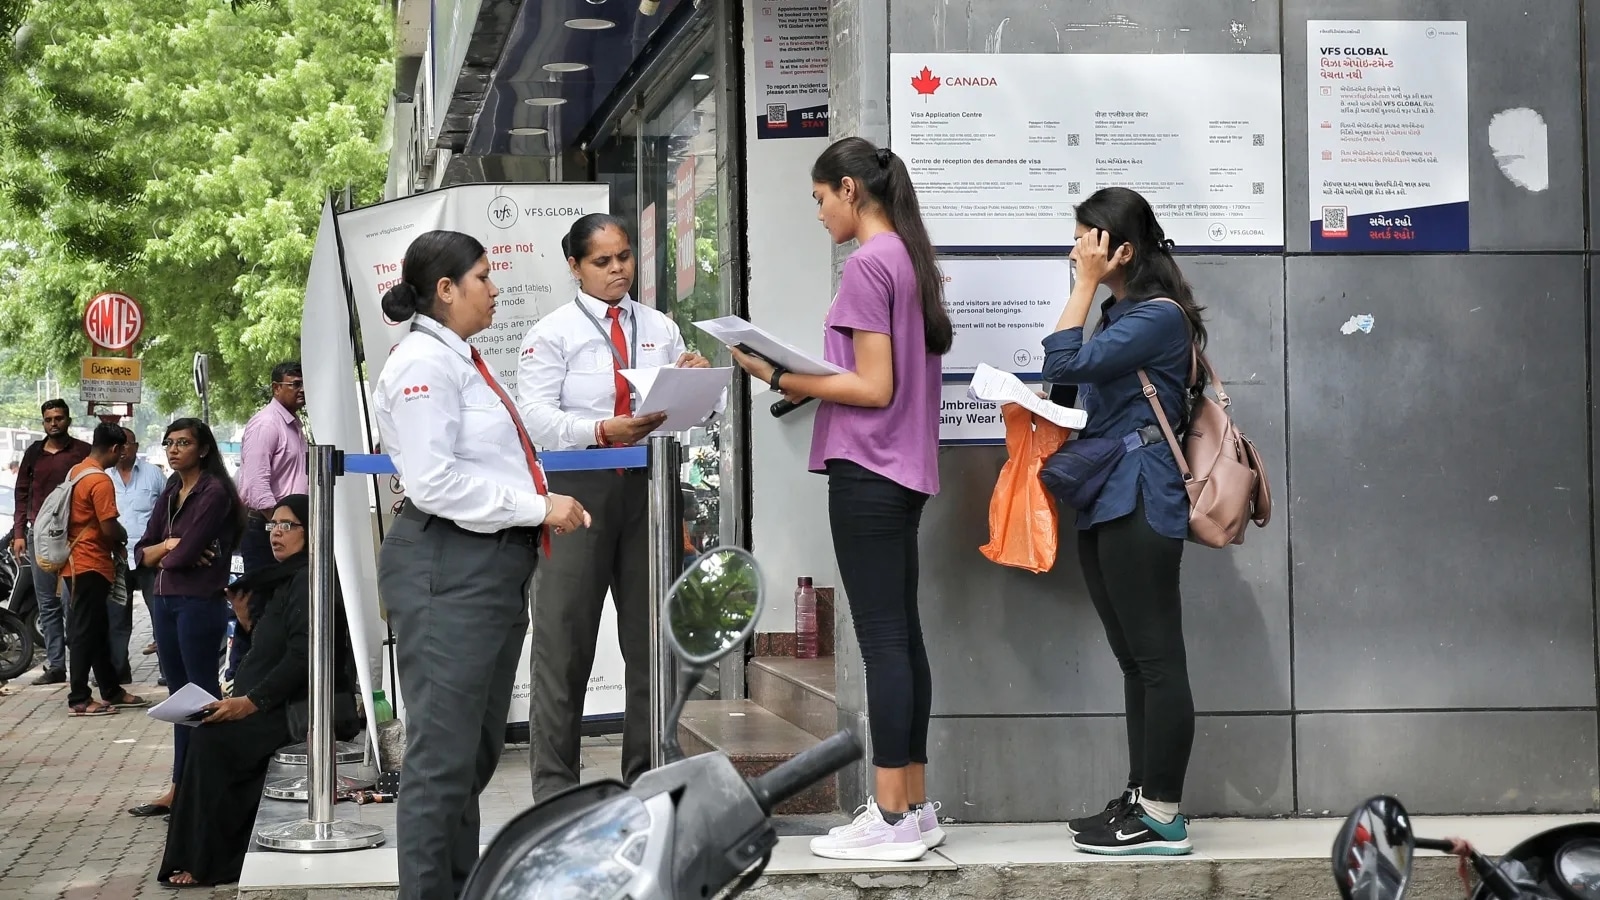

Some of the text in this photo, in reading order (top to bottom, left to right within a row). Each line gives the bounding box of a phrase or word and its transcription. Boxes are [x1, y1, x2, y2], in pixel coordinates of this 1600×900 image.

[1344, 47, 1388, 55] GLOBAL
[1320, 57, 1394, 68] વિઝા એપોઇન્ટમેન્ટ
[1320, 69, 1363, 79] વેચતા નથી
[946, 77, 998, 86] CANADA
[493, 204, 512, 221] vfs.
[525, 208, 586, 217] VFS.GLOBAL
[1369, 215, 1412, 227] સચેત રહો
[366, 223, 414, 238] www.vfsglobal.com
[1369, 229, 1391, 239] સતર્ક
[373, 243, 534, 275] The are not
[507, 284, 552, 293] and tablets)
[502, 298, 525, 307] mode
[89, 297, 137, 344] AMTS
[507, 333, 523, 342] and
[484, 347, 502, 356] after
[966, 414, 996, 423] Wear
